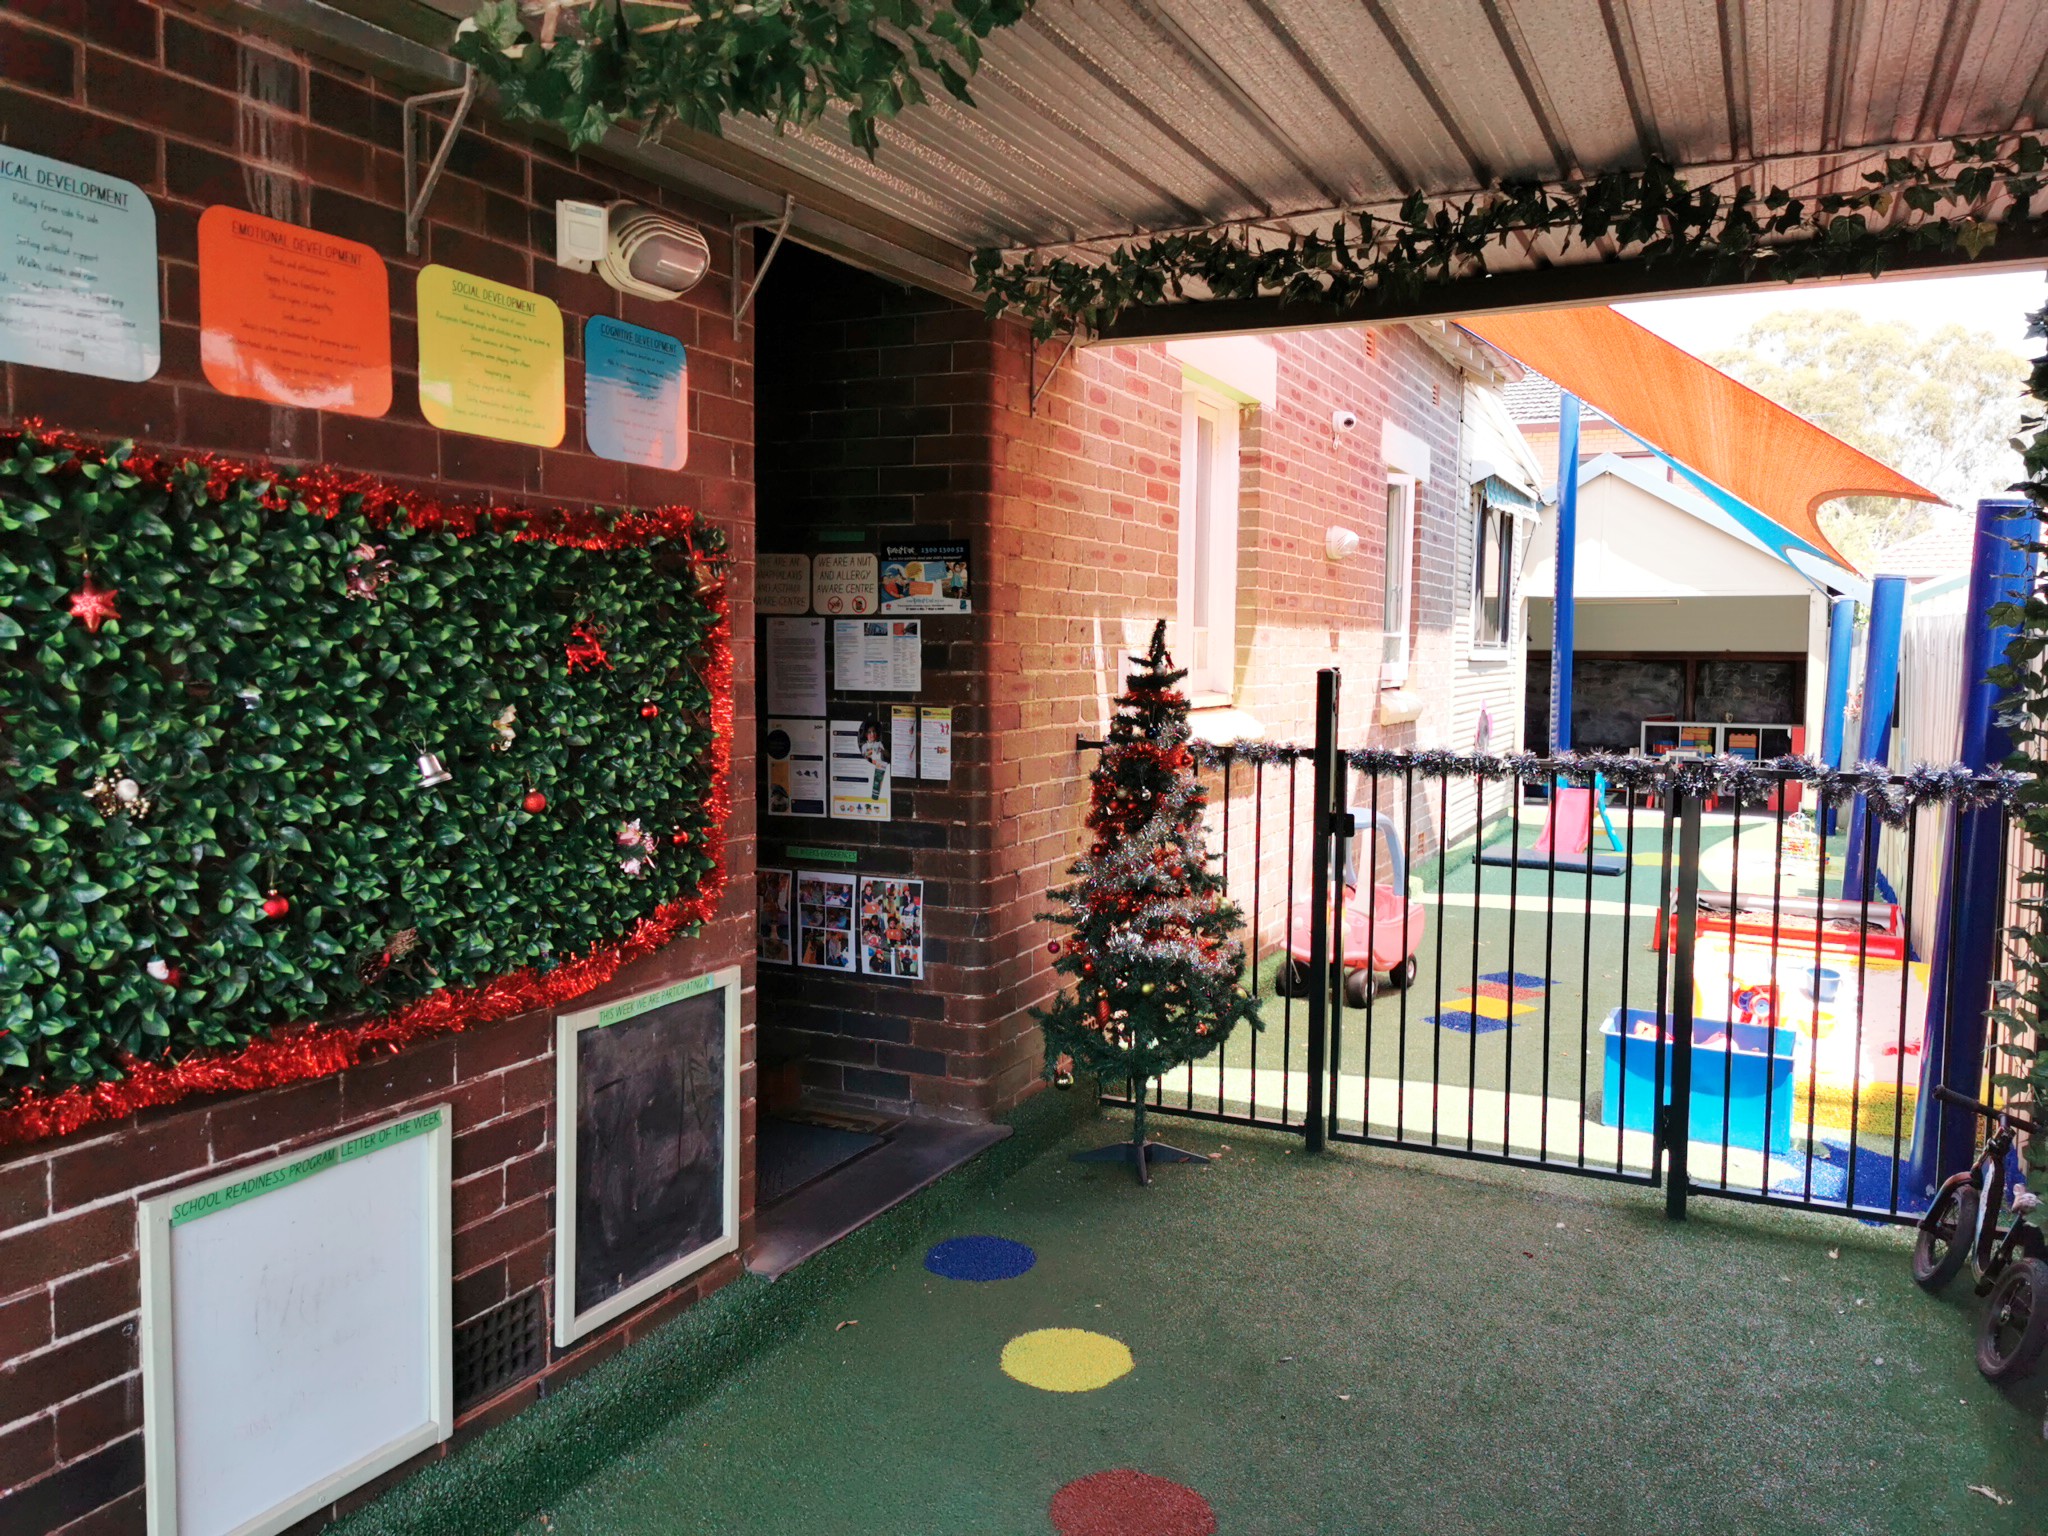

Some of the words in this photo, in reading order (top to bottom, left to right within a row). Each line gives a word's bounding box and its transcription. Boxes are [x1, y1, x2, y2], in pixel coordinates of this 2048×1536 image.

[12, 192, 38, 213] Rolling
[41, 200, 58, 213] from
[37, 169, 128, 207] DEVELOPMENT
[41, 220, 73, 241] Crawling
[232, 220, 288, 248] EMOTIONAL
[293, 237, 362, 265] DEVELOPMENT
[452, 280, 481, 298] SOCIAL
[482, 288, 536, 314] DEVELOPMENT
[600, 323, 634, 342] COGNITIVE
[635, 332, 677, 353] DEVELOPMENT
[818, 556, 831, 567] WE
[833, 556, 848, 567] ARE
[849, 556, 856, 567] A
[857, 556, 873, 567] NUT
[819, 570, 835, 581] AND
[837, 570, 871, 581] ALLERGY
[816, 583, 844, 594] AWARE
[845, 583, 875, 594] CENTRE
[600, 1010, 614, 1022] THIS
[615, 1003, 635, 1018] WEEK
[636, 998, 649, 1010] WE
[649, 993, 660, 1005] ARE
[661, 982, 703, 1000] PARTICIPATING
[703, 978, 710, 989] IN
[341, 1134, 376, 1157] LETTER
[379, 1128, 393, 1144] OF
[394, 1122, 411, 1138] THE
[414, 1111, 440, 1132] WEEK
[173, 1191, 222, 1220] SCHOOL
[225, 1174, 286, 1201] READINESS
[289, 1147, 336, 1176] PROGRAM
